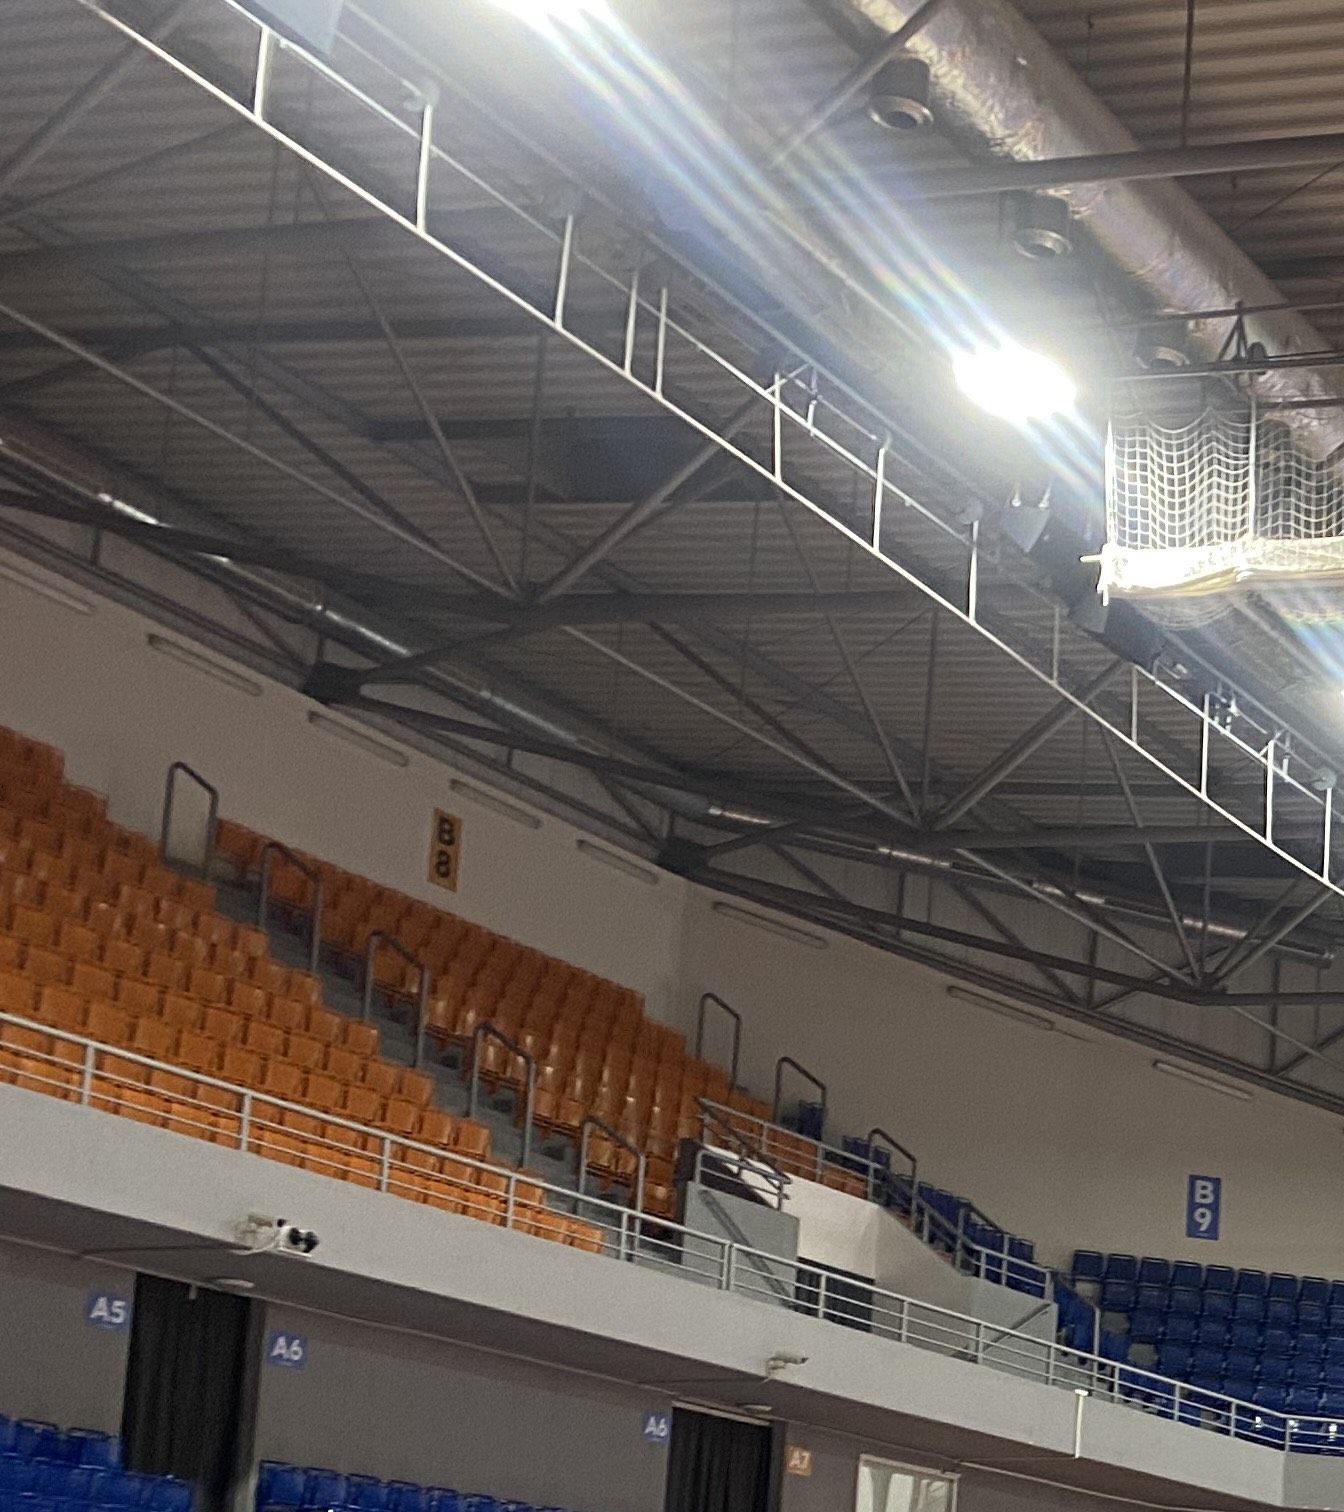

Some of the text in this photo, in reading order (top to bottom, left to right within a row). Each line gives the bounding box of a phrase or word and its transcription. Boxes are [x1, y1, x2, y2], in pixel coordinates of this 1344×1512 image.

[90, 1296, 126, 1324] A5
[270, 1336, 304, 1361] A6
[644, 1416, 669, 1437] A6
